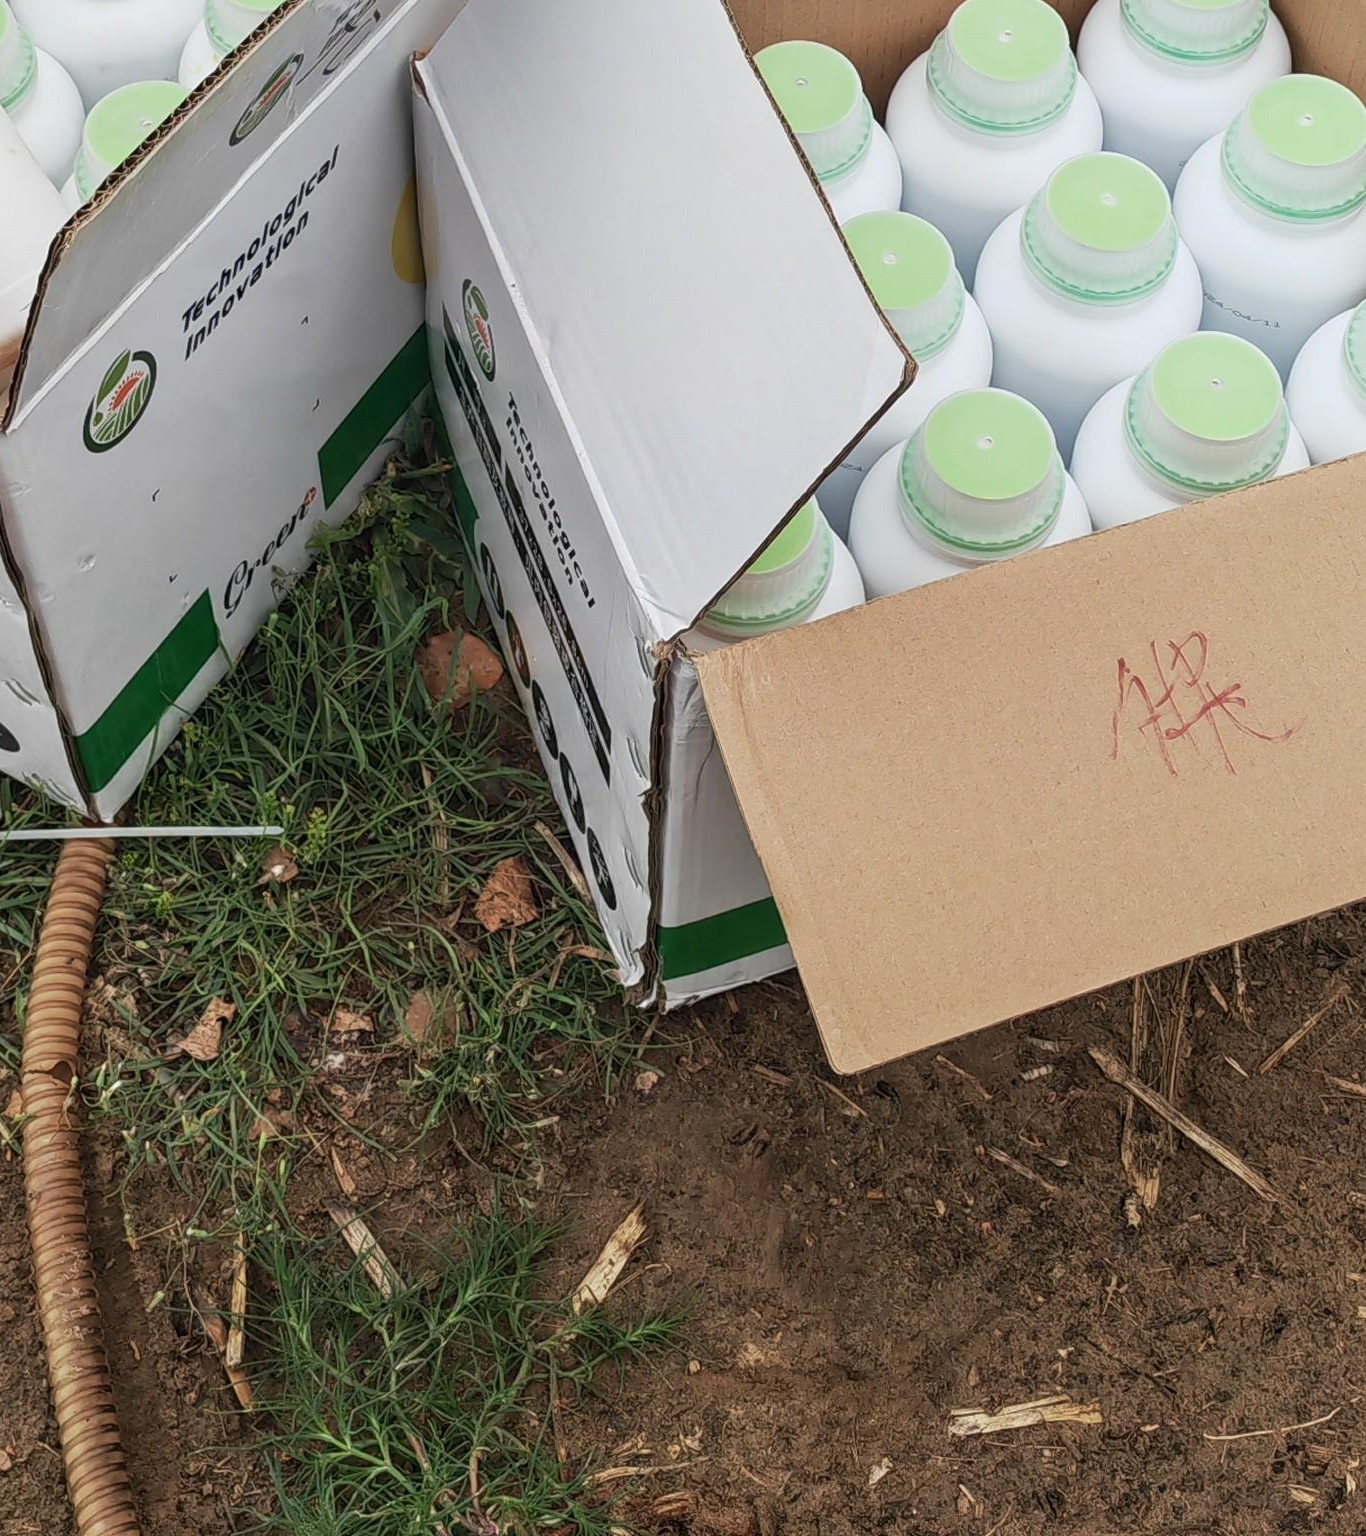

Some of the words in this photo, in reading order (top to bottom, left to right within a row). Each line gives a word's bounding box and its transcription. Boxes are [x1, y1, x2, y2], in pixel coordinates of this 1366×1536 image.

[181, 143, 340, 333] Technological
[184, 211, 310, 362] Innovation
[505, 416, 575, 588] Innovation
[507, 389, 597, 610] Technological
